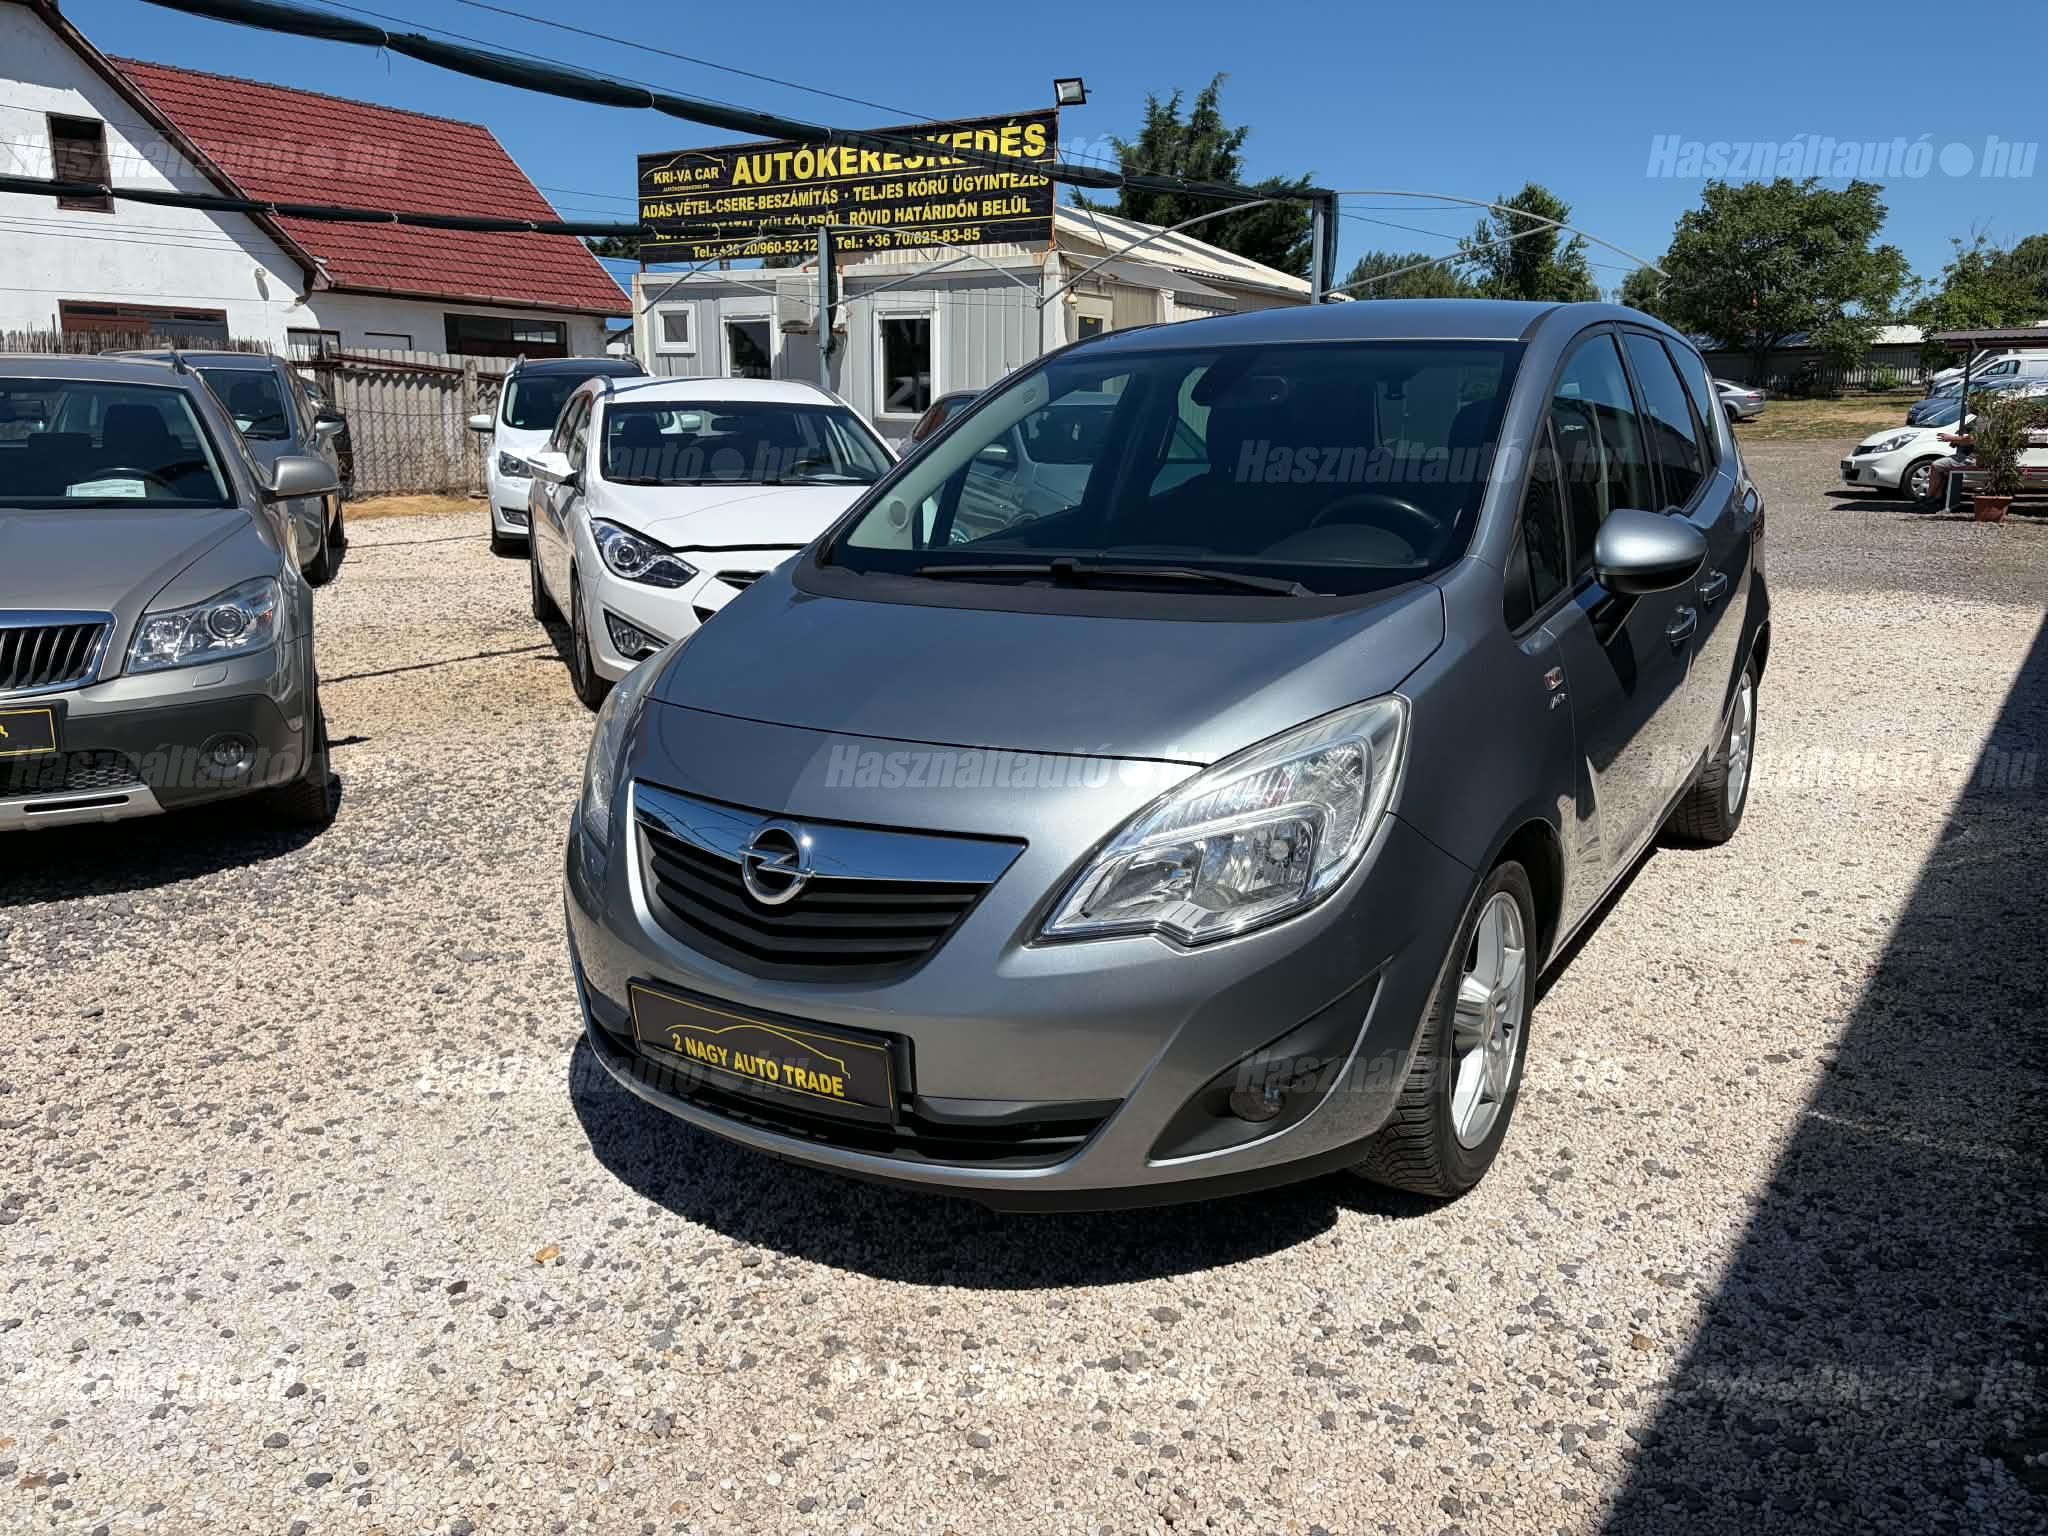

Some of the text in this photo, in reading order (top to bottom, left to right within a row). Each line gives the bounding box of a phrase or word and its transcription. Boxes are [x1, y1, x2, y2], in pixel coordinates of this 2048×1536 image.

[653, 167, 719, 185] KRI-VA CAR
[853, 181, 904, 202] TELJES
[849, 207, 891, 226] RÖVID
[894, 198, 978, 223] HATÁRIDŐN
[982, 195, 1032, 217] BELÜL
[835, 236, 863, 250] Tel.:
[866, 234, 891, 248] +36
[671, 1032, 683, 1052] 2
[685, 1036, 729, 1067] NAGY
[734, 1051, 780, 1082] AUTO
[783, 1064, 845, 1097] TRADE
